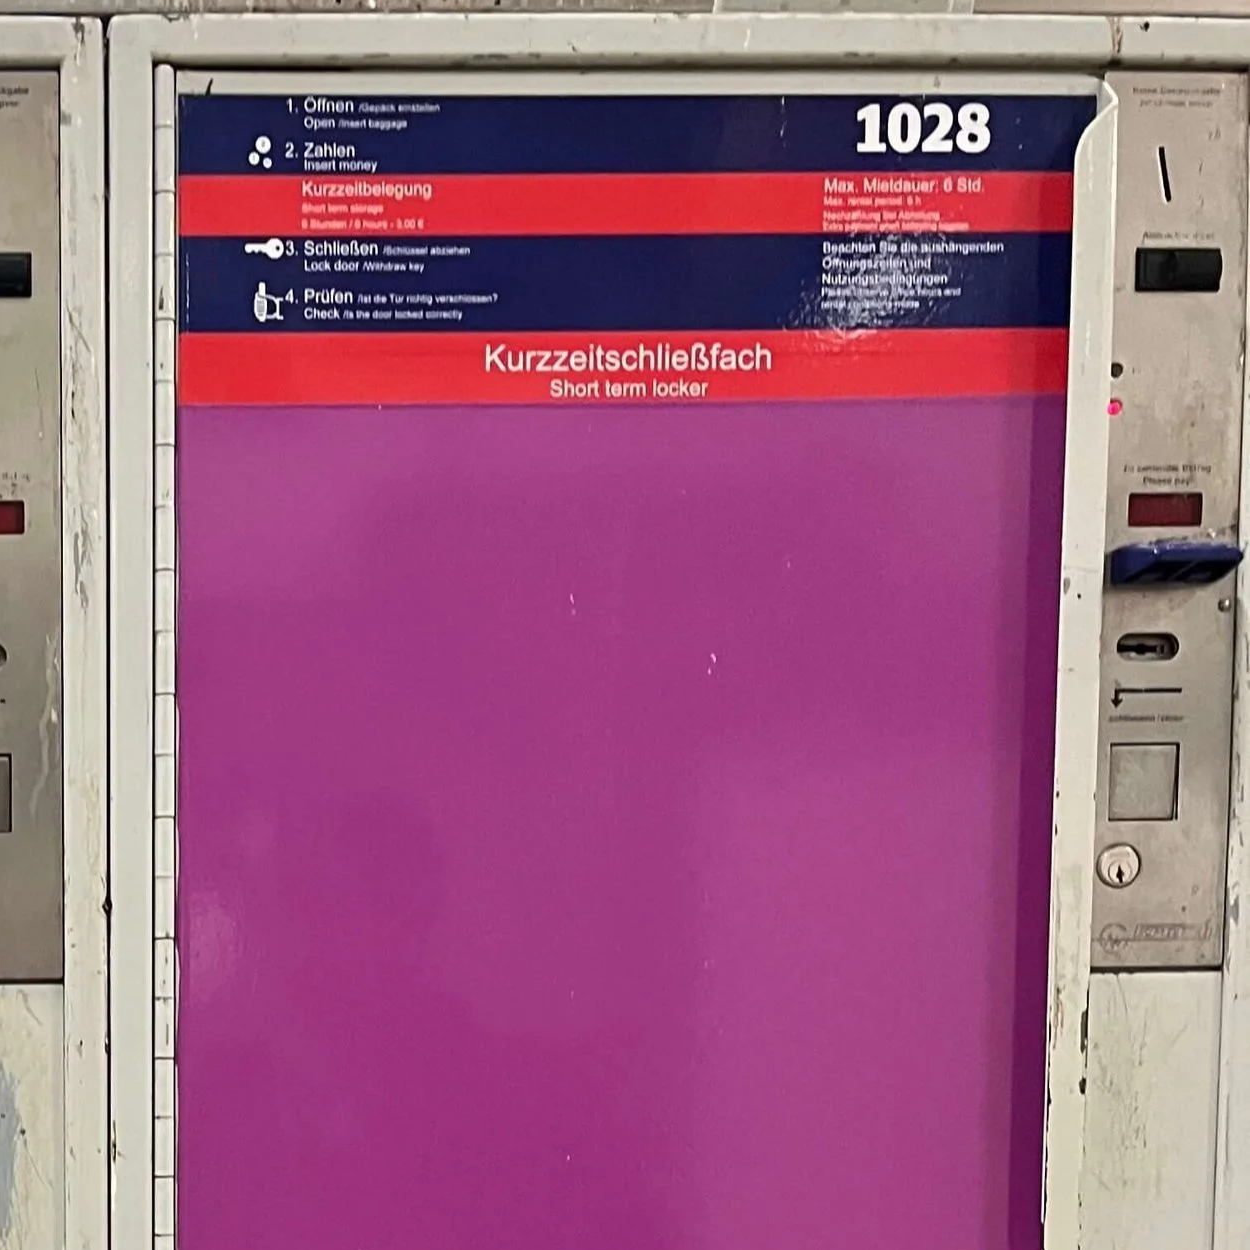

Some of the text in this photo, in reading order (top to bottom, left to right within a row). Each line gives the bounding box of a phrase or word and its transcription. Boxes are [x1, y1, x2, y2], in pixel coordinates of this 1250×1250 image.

[286, 96, 354, 114] 1. Öffnen
[303, 118, 335, 131] Open
[856, 102, 991, 154] 1028
[285, 142, 355, 159] 2. Zahlen
[303, 160, 378, 173] Insert money
[301, 181, 433, 201] Kurzzeitbelegung
[824, 177, 985, 193] Max. Mietdauer: 6 Std.
[285, 240, 379, 257] 3. Schließen
[822, 240, 1005, 256] Beachten Sie die aushängenden
[303, 259, 359, 273] Lock door
[907, 257, 931, 269] und
[821, 273, 948, 287] Nutzungsbedingungen
[285, 288, 354, 304] 4. Prüfen
[303, 308, 340, 320] Check
[485, 342, 772, 373] Kurzzeitschließfach
[550, 378, 708, 398] Short term locker
